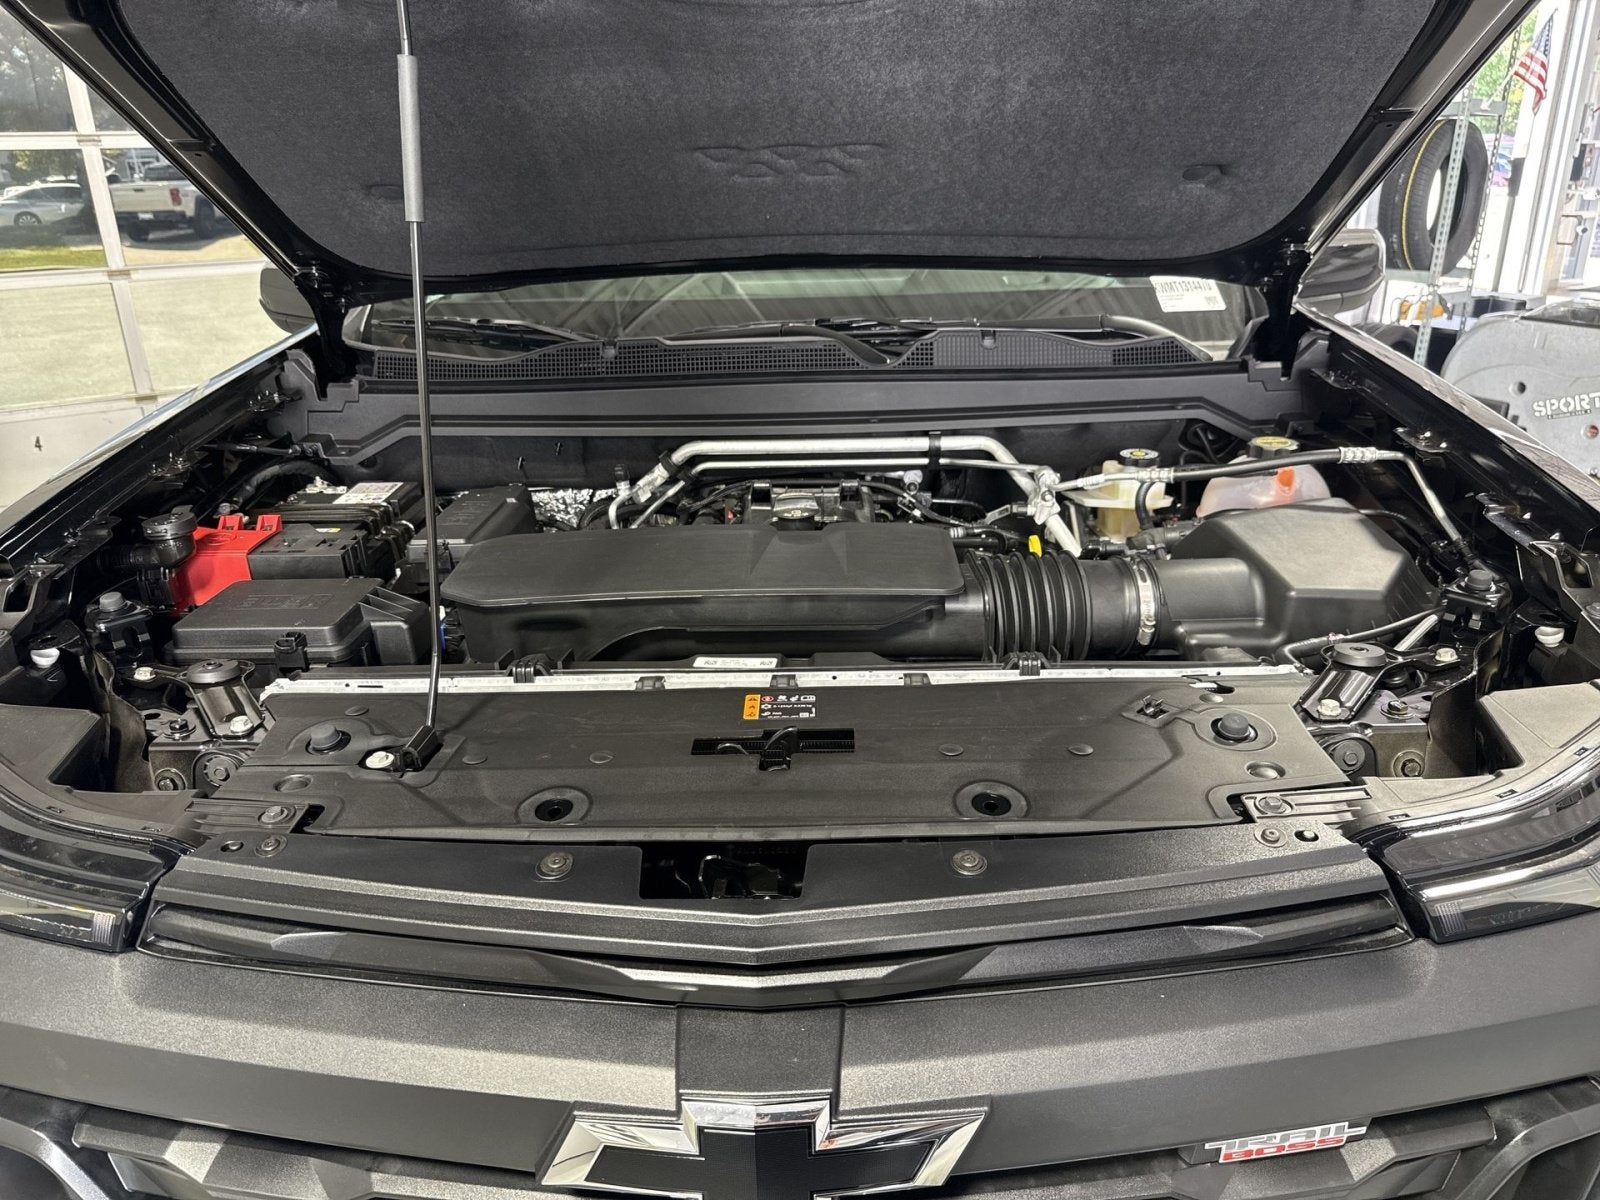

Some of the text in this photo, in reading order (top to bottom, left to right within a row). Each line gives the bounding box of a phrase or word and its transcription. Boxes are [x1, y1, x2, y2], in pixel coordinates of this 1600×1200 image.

[1533, 392, 1600, 417] SPORT
[34, 436, 43, 452] 4
[1205, 1123, 1367, 1150] TRAIL
[1222, 1136, 1345, 1162] BOSS
